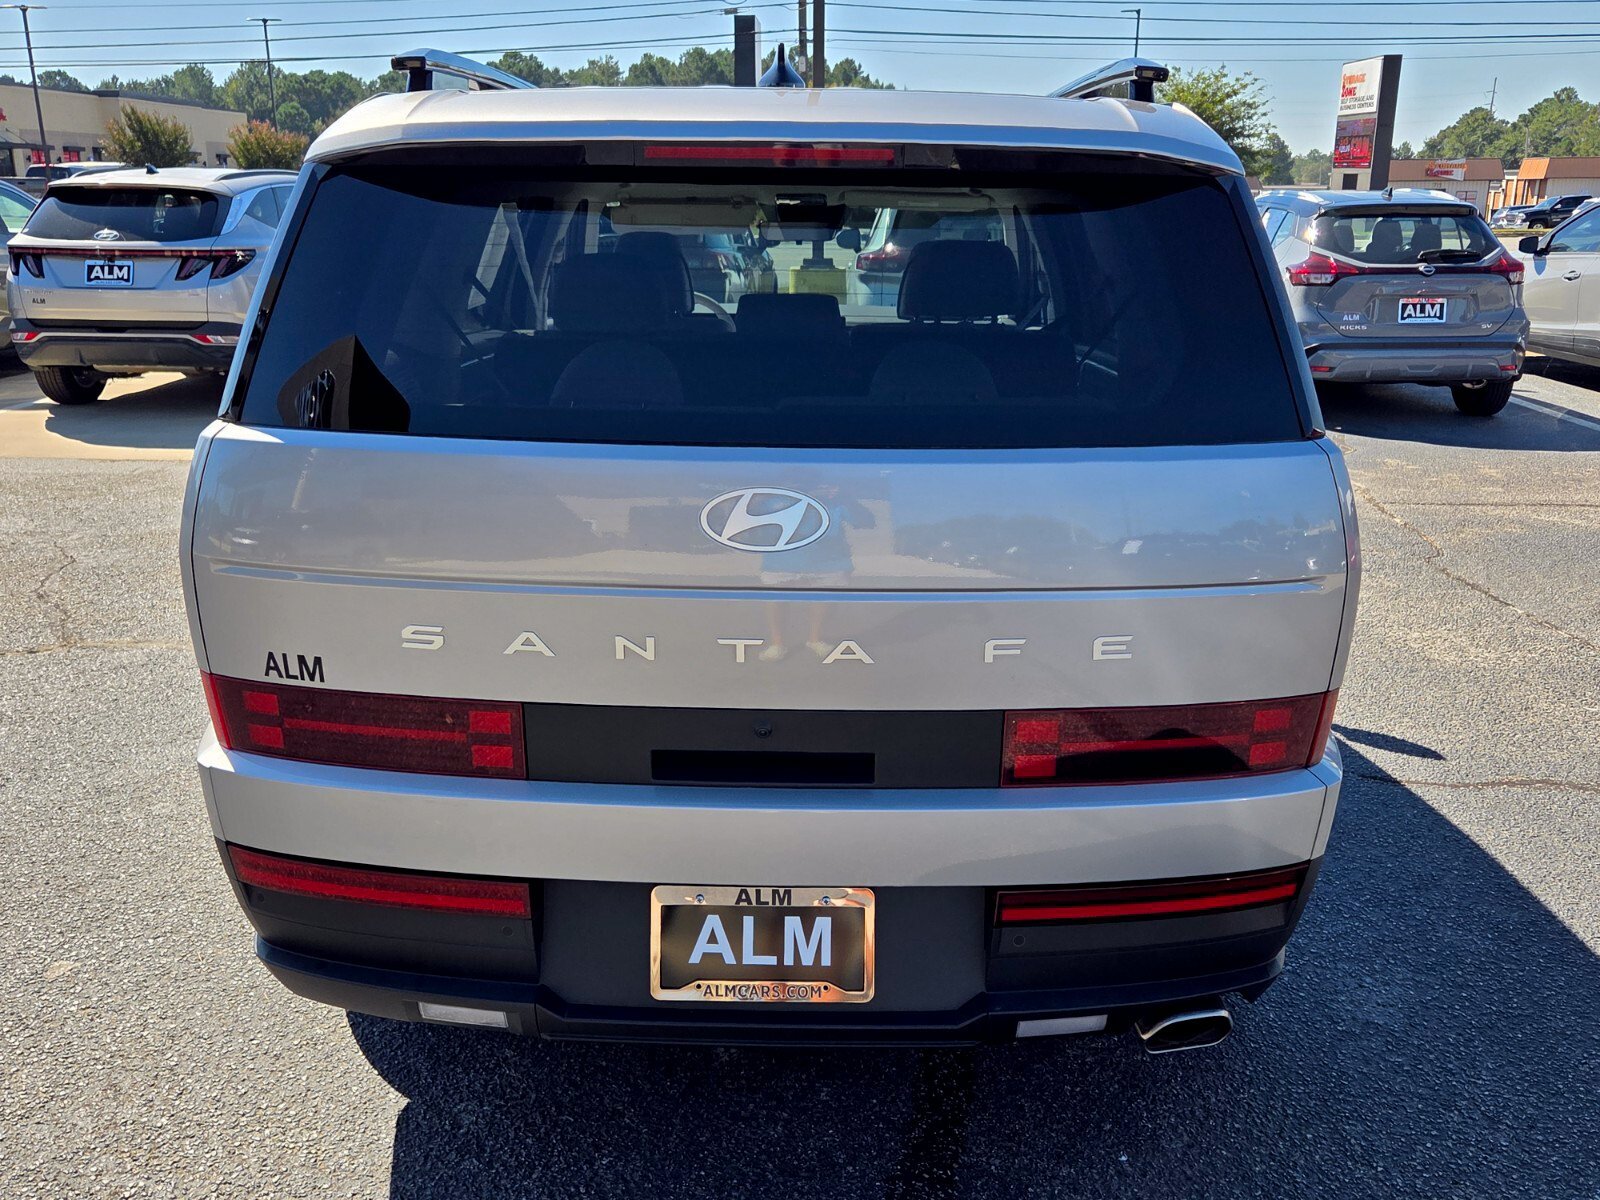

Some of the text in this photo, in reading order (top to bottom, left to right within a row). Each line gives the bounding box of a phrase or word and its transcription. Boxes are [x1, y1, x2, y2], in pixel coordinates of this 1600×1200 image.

[90, 265, 128, 280] ALM
[1403, 304, 1441, 318] ALM
[401, 624, 1134, 664] SANTA FE
[264, 651, 326, 683] ALM
[735, 888, 792, 906] ALM
[688, 914, 832, 967] ALM
[703, 984, 822, 999] ALMCARS.COM
